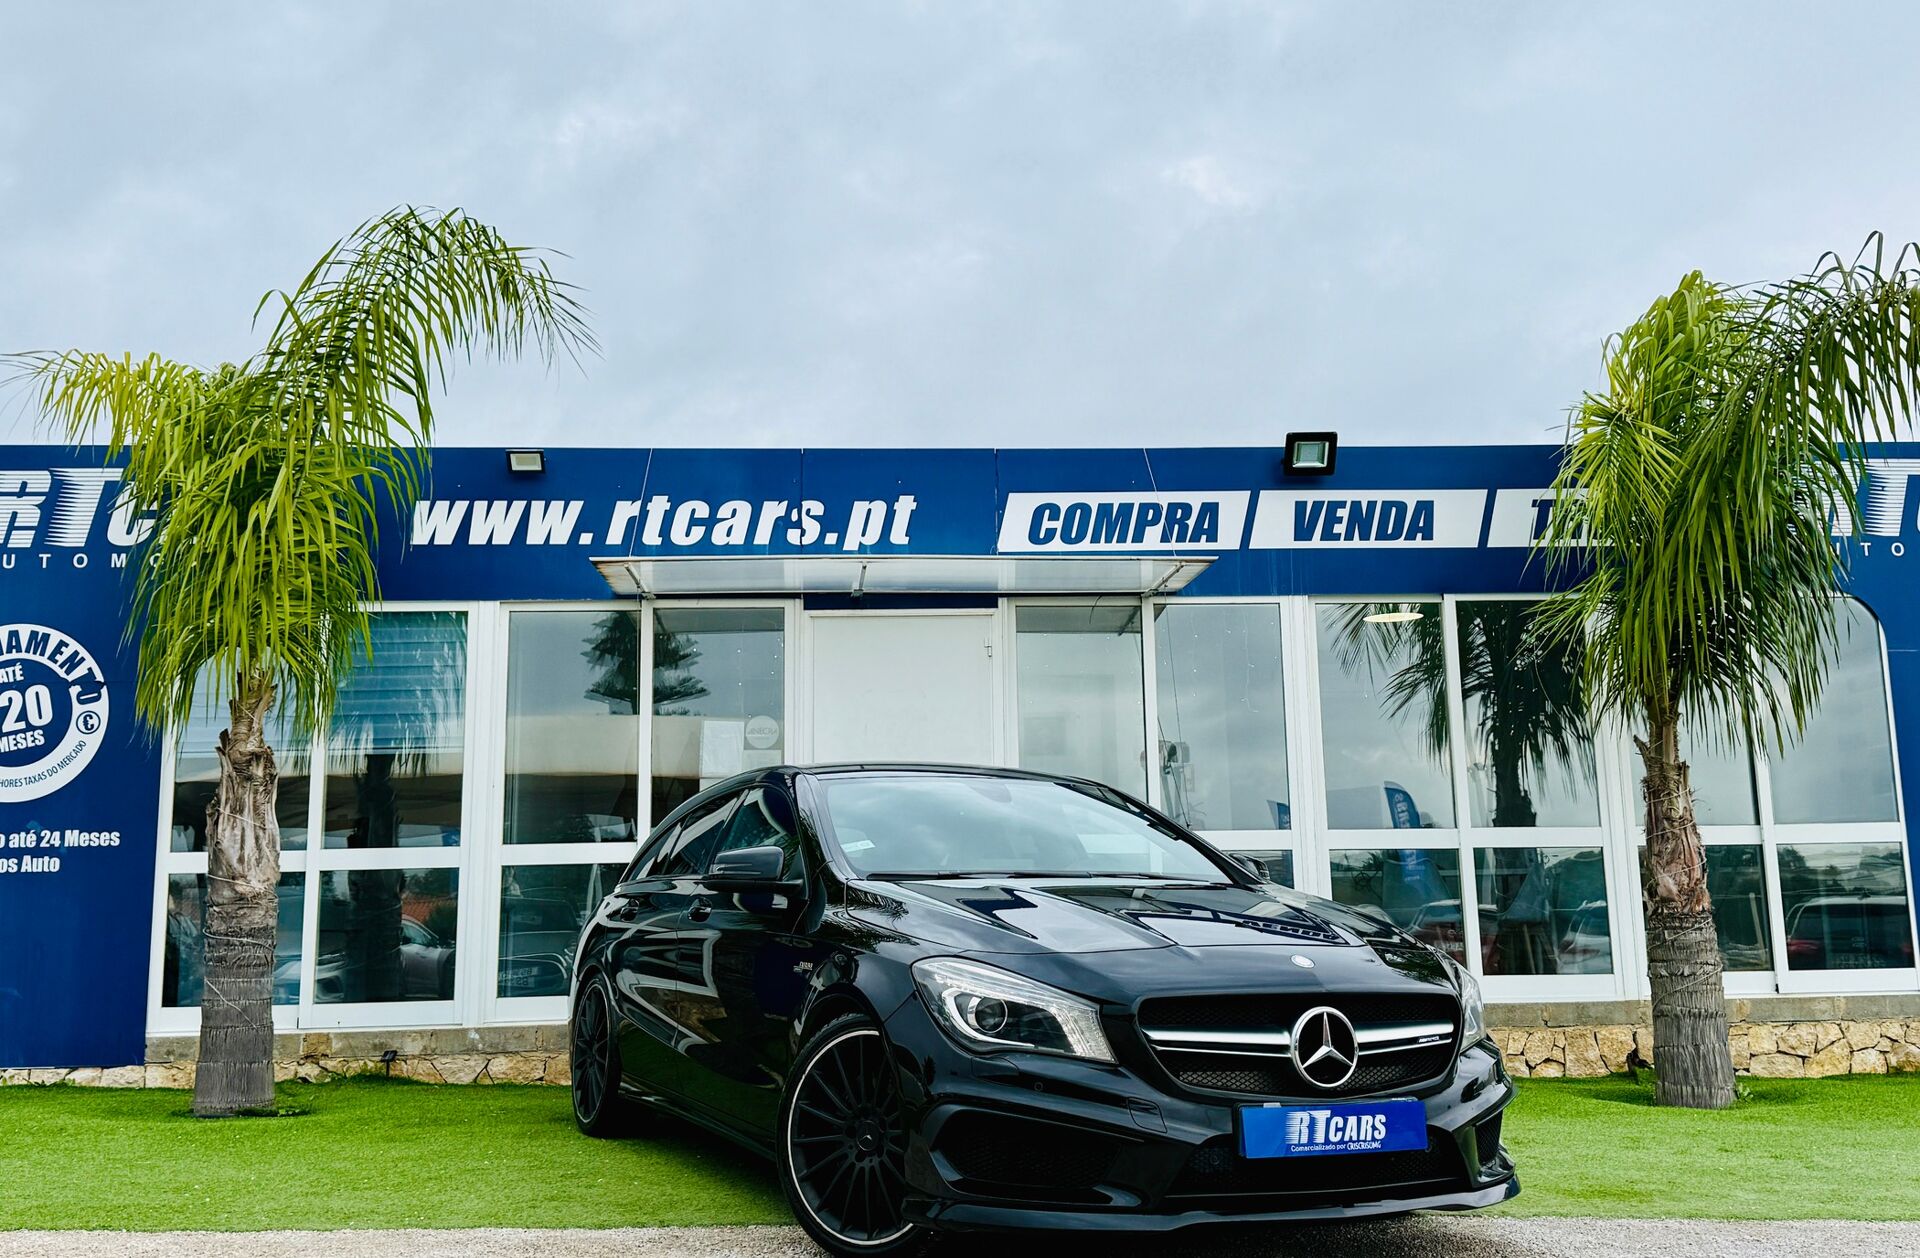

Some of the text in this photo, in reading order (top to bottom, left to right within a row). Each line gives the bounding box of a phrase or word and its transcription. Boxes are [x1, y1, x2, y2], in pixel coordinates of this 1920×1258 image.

[411, 496, 917, 551] www.rtcars.pt
[1028, 501, 1220, 546] COMPRA
[1293, 500, 1435, 542] VENDA
[0, 684, 54, 733] 20
[24, 771, 47, 786] TAXAS
[47, 766, 59, 778] DO
[57, 740, 87, 770] MERCADO
[9, 829, 38, 849] até
[40, 829, 61, 848] 24
[64, 829, 121, 847] Meses
[21, 854, 61, 873] Auto
[1290, 1144, 1336, 1153] Comercializado
